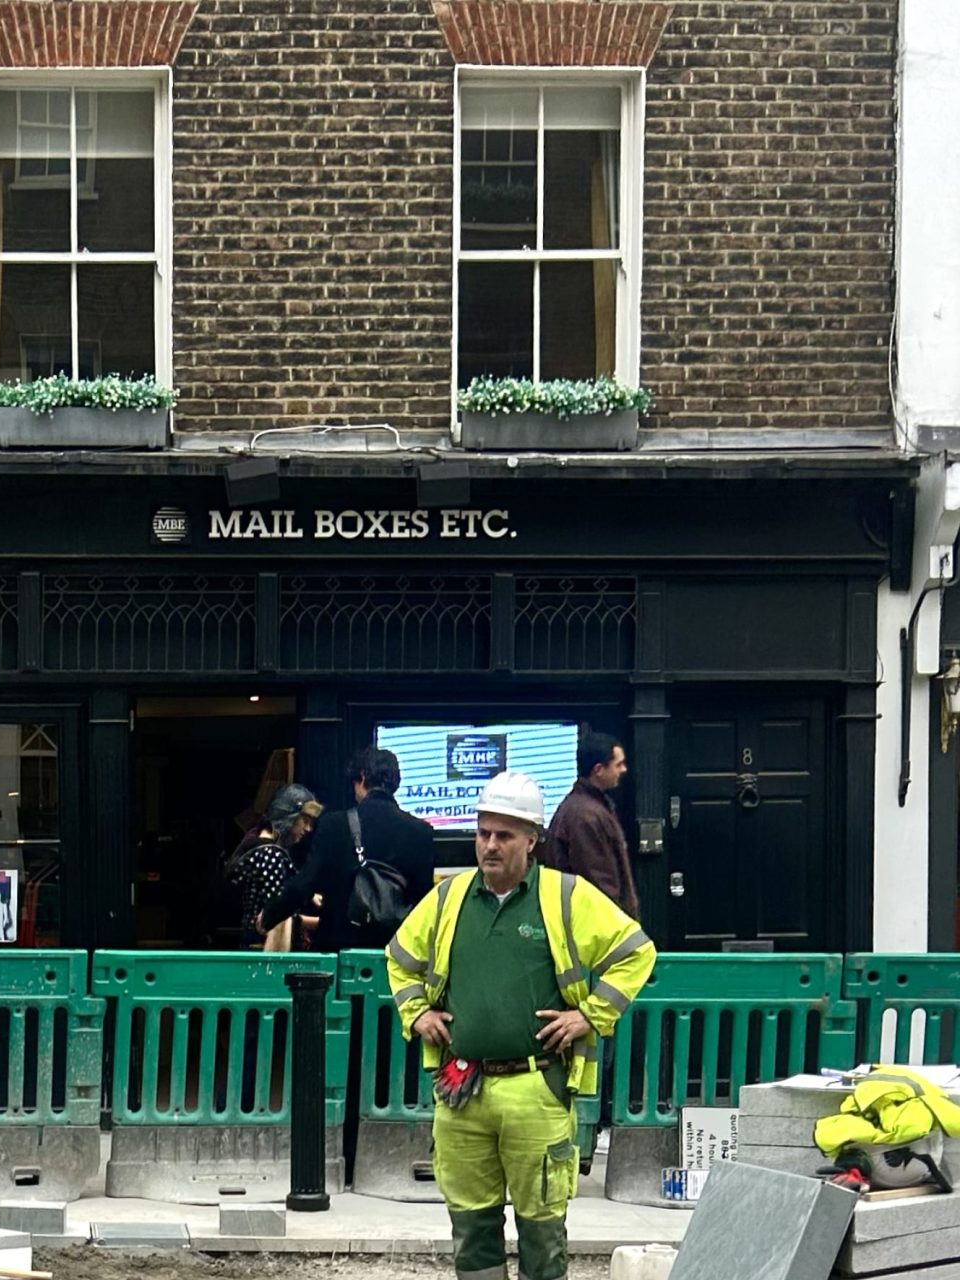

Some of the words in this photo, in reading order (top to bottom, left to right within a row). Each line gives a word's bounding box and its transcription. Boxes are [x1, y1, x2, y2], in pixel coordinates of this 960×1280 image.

[158, 519, 185, 531] MBE
[207, 510, 303, 538] MAIL
[314, 510, 428, 539] BOXES
[440, 510, 517, 539] ETC.
[742, 747, 753, 765] 8
[456, 785, 485, 798] BO
[686, 1121, 694, 1151] within
[696, 1129, 704, 1143] No
[709, 1133, 717, 1141] 4
[730, 1114, 738, 1150] quoting
[696, 1146, 704, 1168] retur
